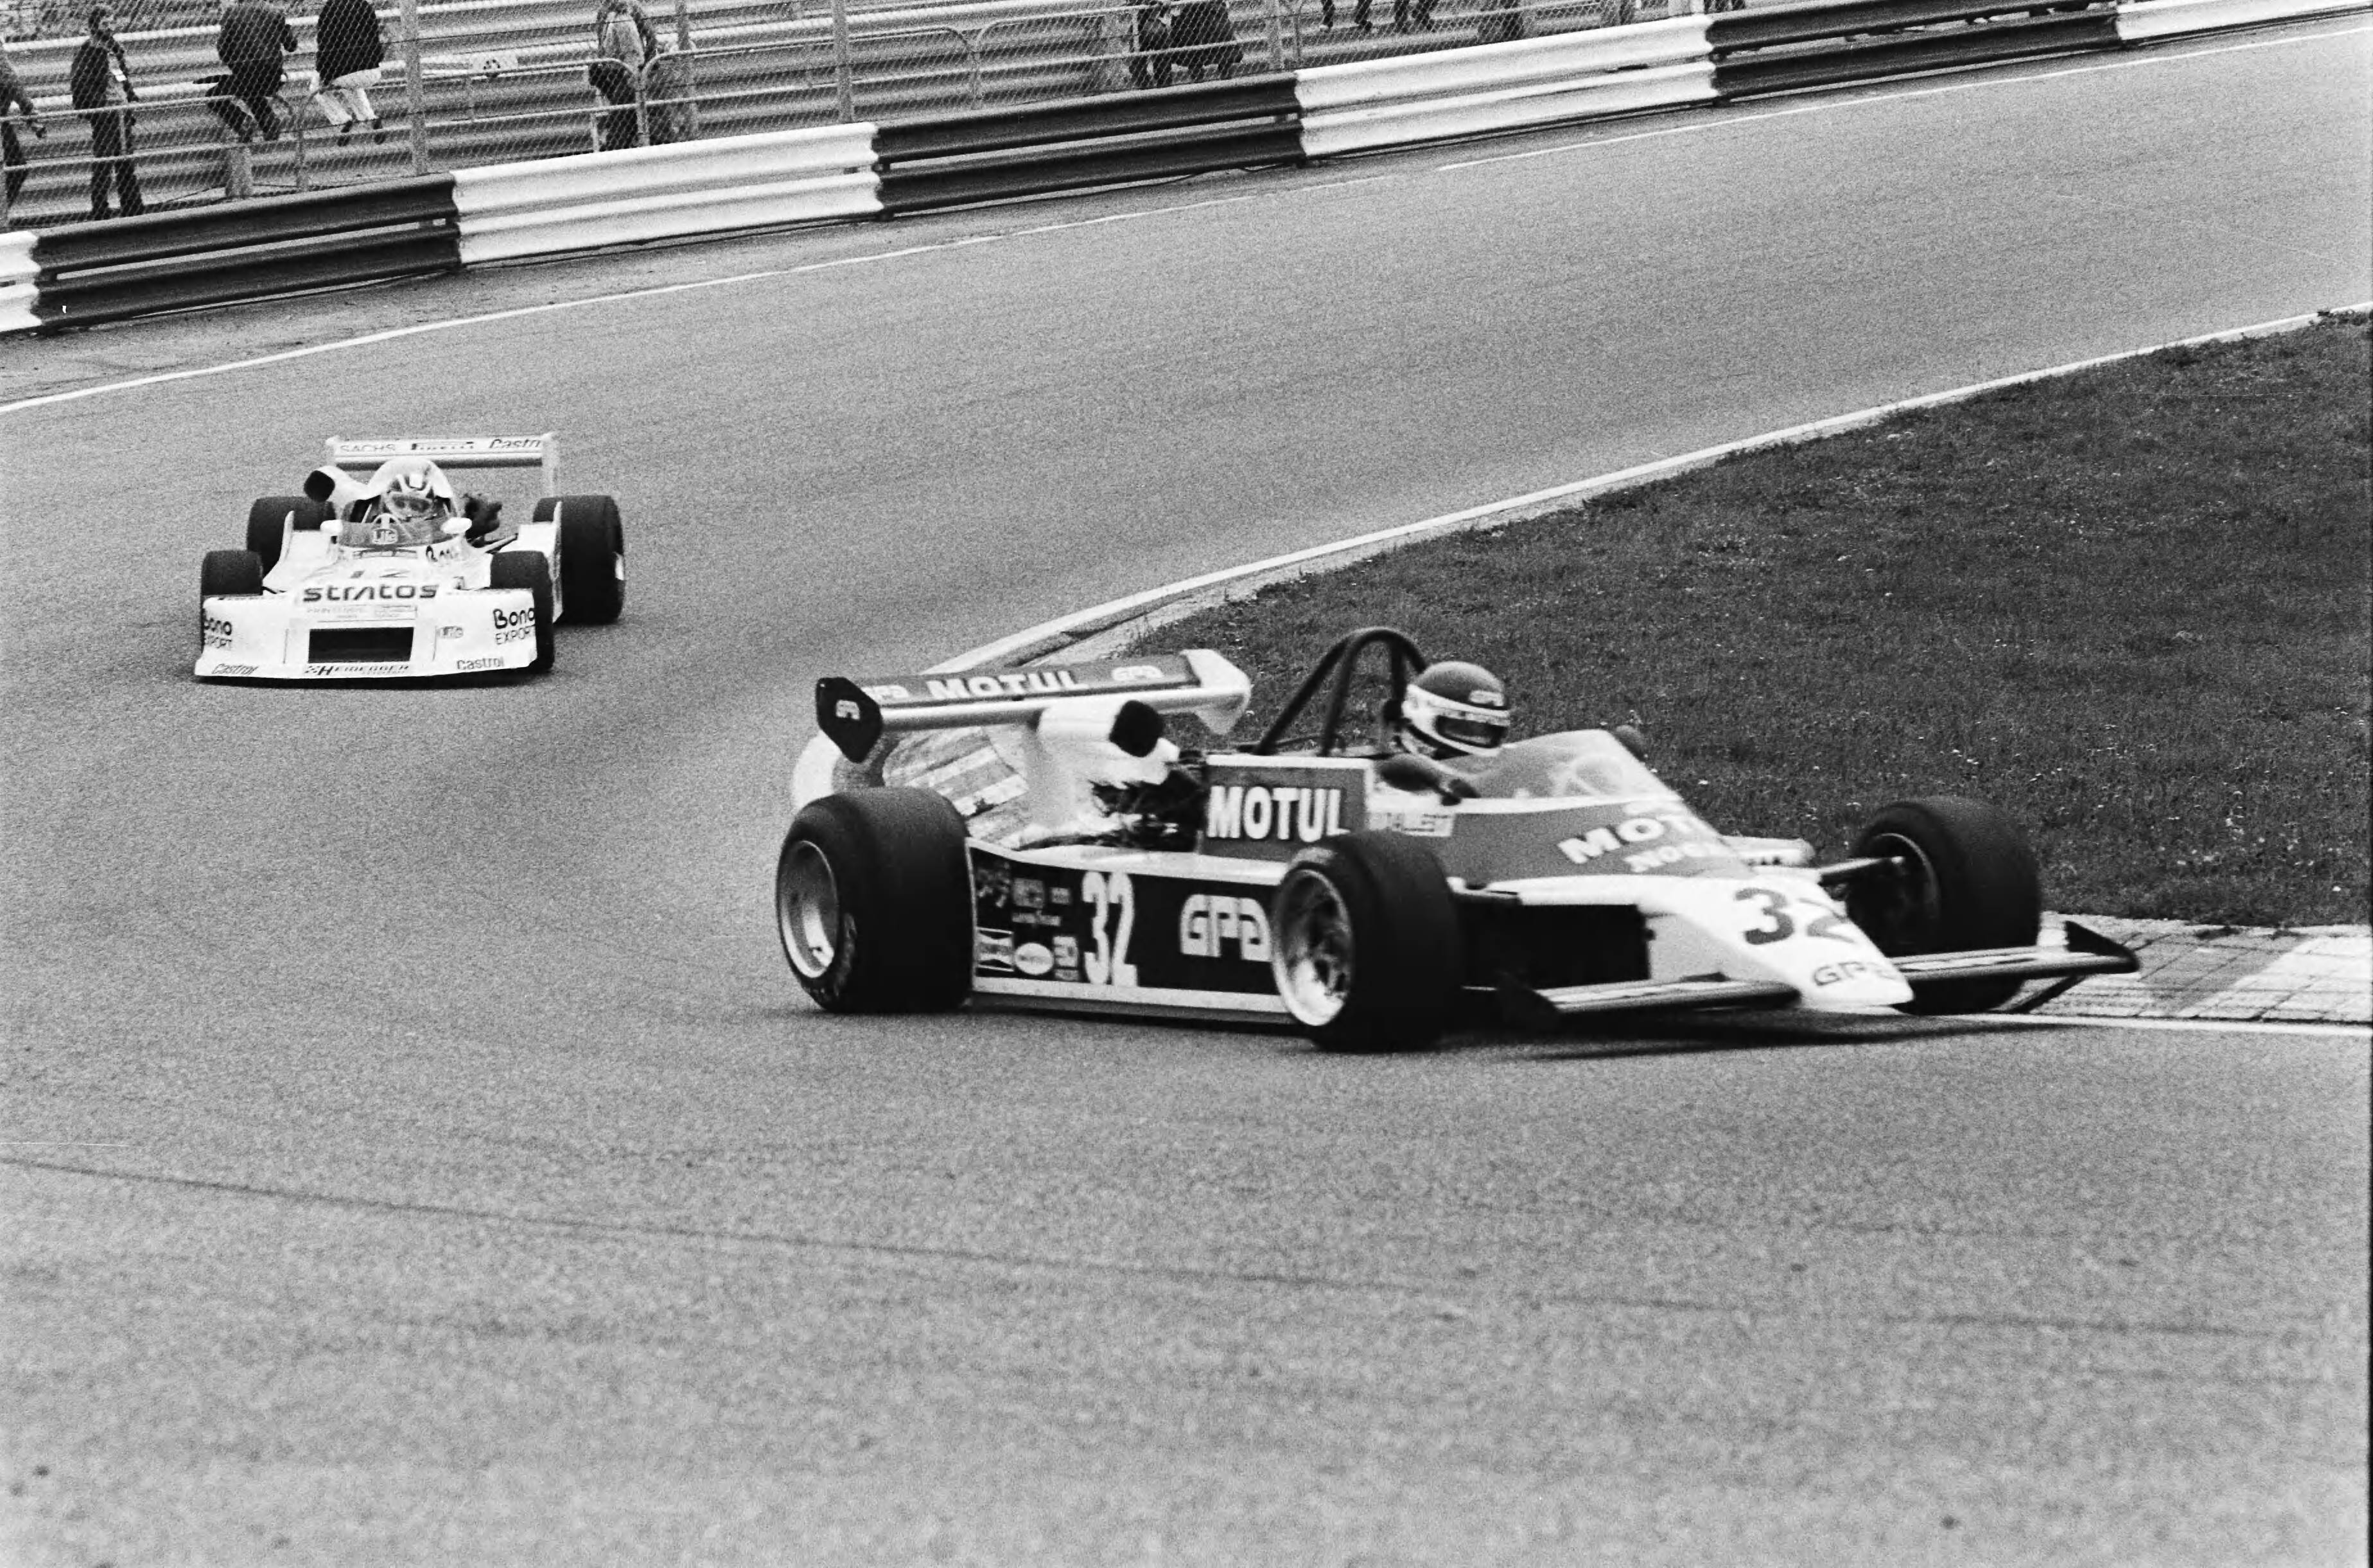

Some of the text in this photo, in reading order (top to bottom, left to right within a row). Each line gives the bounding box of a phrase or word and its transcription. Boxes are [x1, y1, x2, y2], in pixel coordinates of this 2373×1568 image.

[302, 584, 439, 602] stratos
[457, 656, 505, 670] Castrol
[925, 670, 1088, 701] MOTUL
[1208, 785, 1349, 842] MOTUL
[1558, 812, 1702, 865] MOT
[1081, 870, 1139, 987] 32
[1735, 887, 1856, 946] 32
